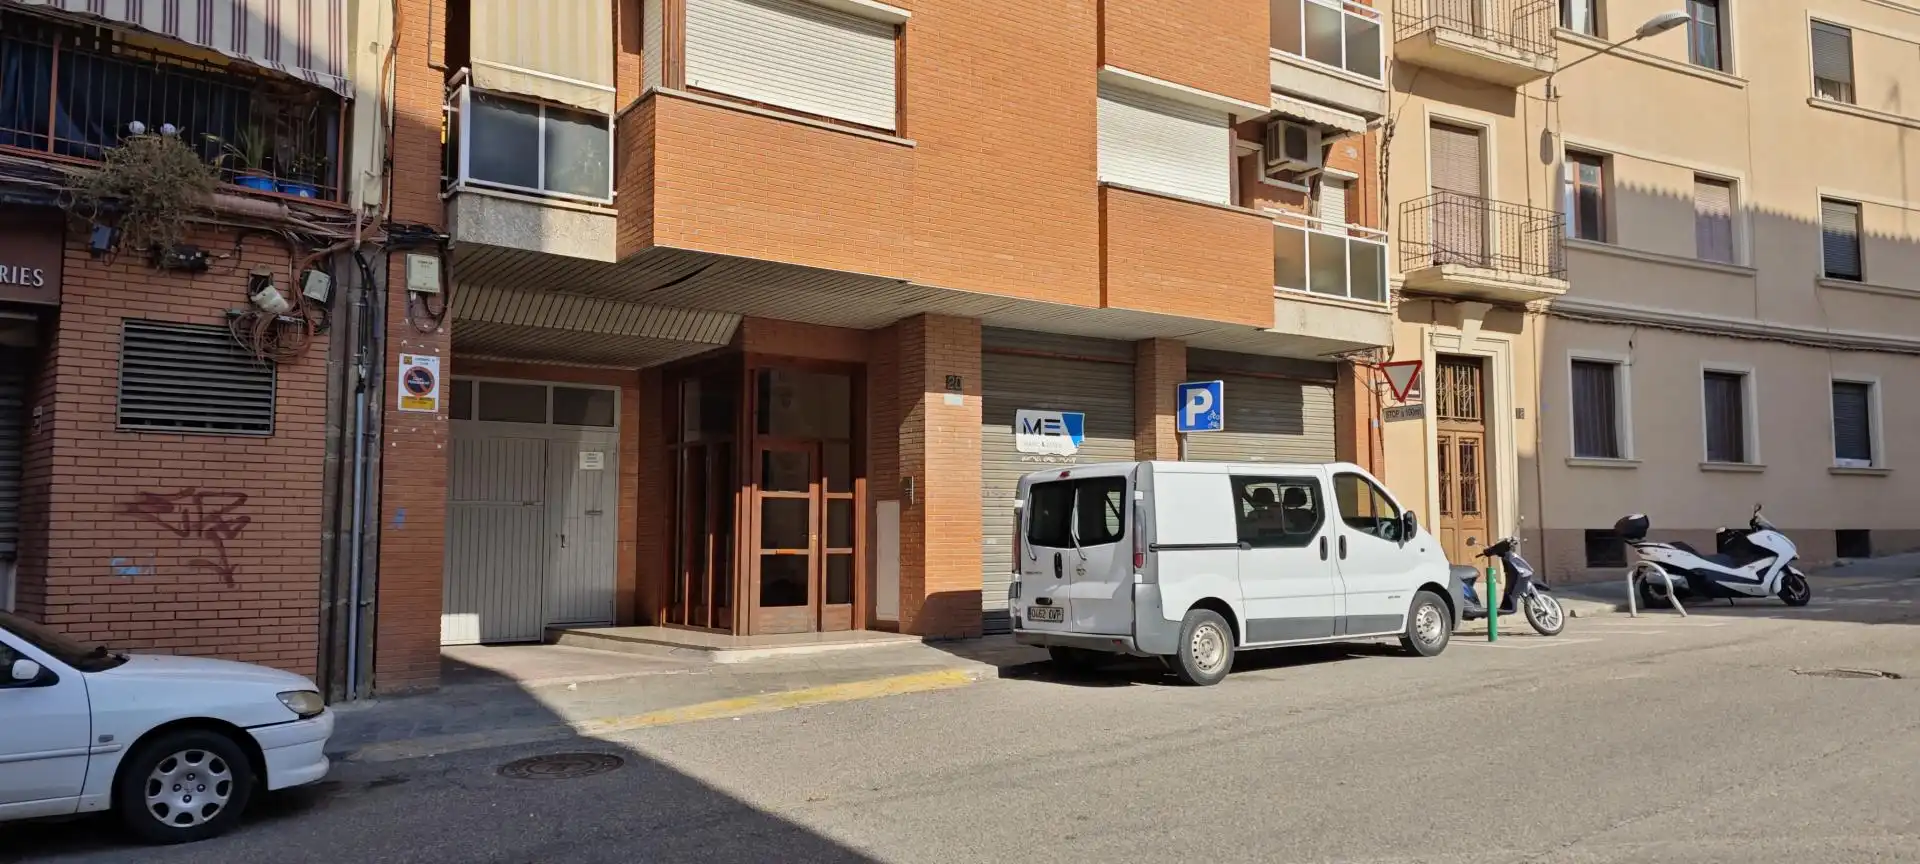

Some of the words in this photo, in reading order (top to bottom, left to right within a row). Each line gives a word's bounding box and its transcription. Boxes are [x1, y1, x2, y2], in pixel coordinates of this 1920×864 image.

[0, 265, 44, 287] RIES
[947, 376, 962, 390] 20
[1186, 388, 1213, 426] P
[1385, 409, 1400, 419] STOP
[1023, 417, 1061, 437] ME
